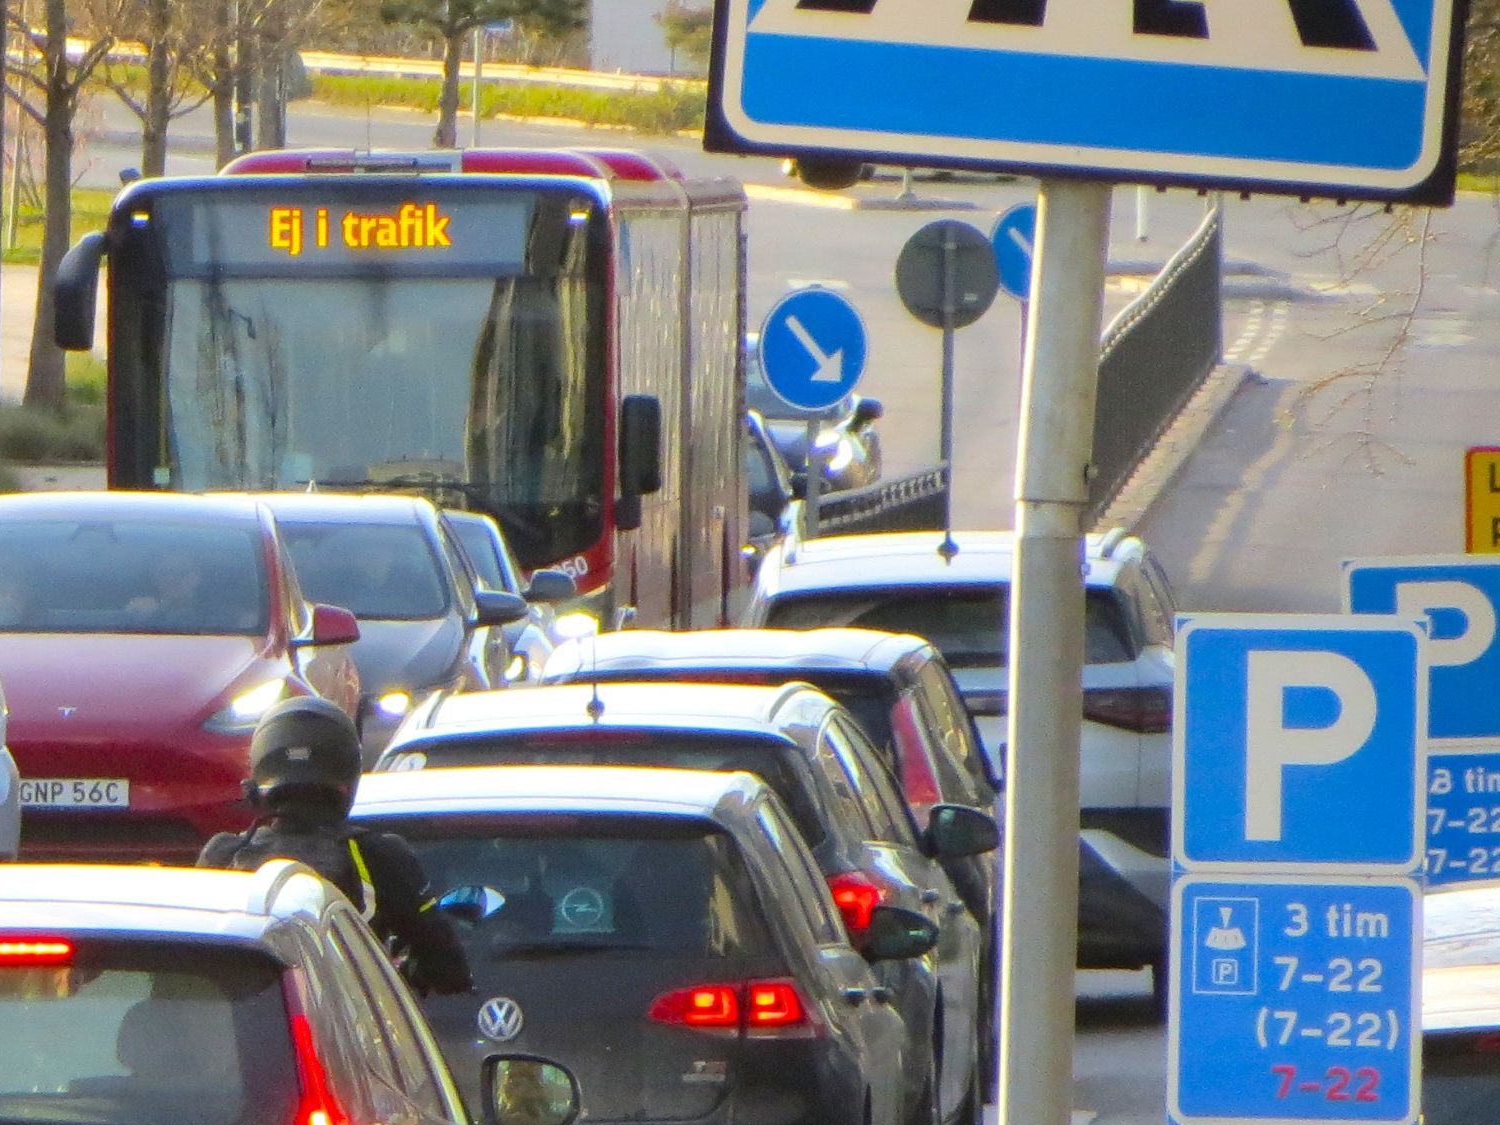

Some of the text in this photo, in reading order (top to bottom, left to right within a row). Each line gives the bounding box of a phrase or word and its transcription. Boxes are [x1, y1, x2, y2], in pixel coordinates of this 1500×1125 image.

[271, 203, 452, 255] Ej i trafik
[1244, 650, 1377, 841] P
[21, 782, 118, 802] GNP 56C
[1284, 903, 1389, 938] 3 tim
[1273, 956, 1383, 992] 7-22
[1257, 1006, 1399, 1050] (7-22)
[1272, 1064, 1380, 1102] 7-22
